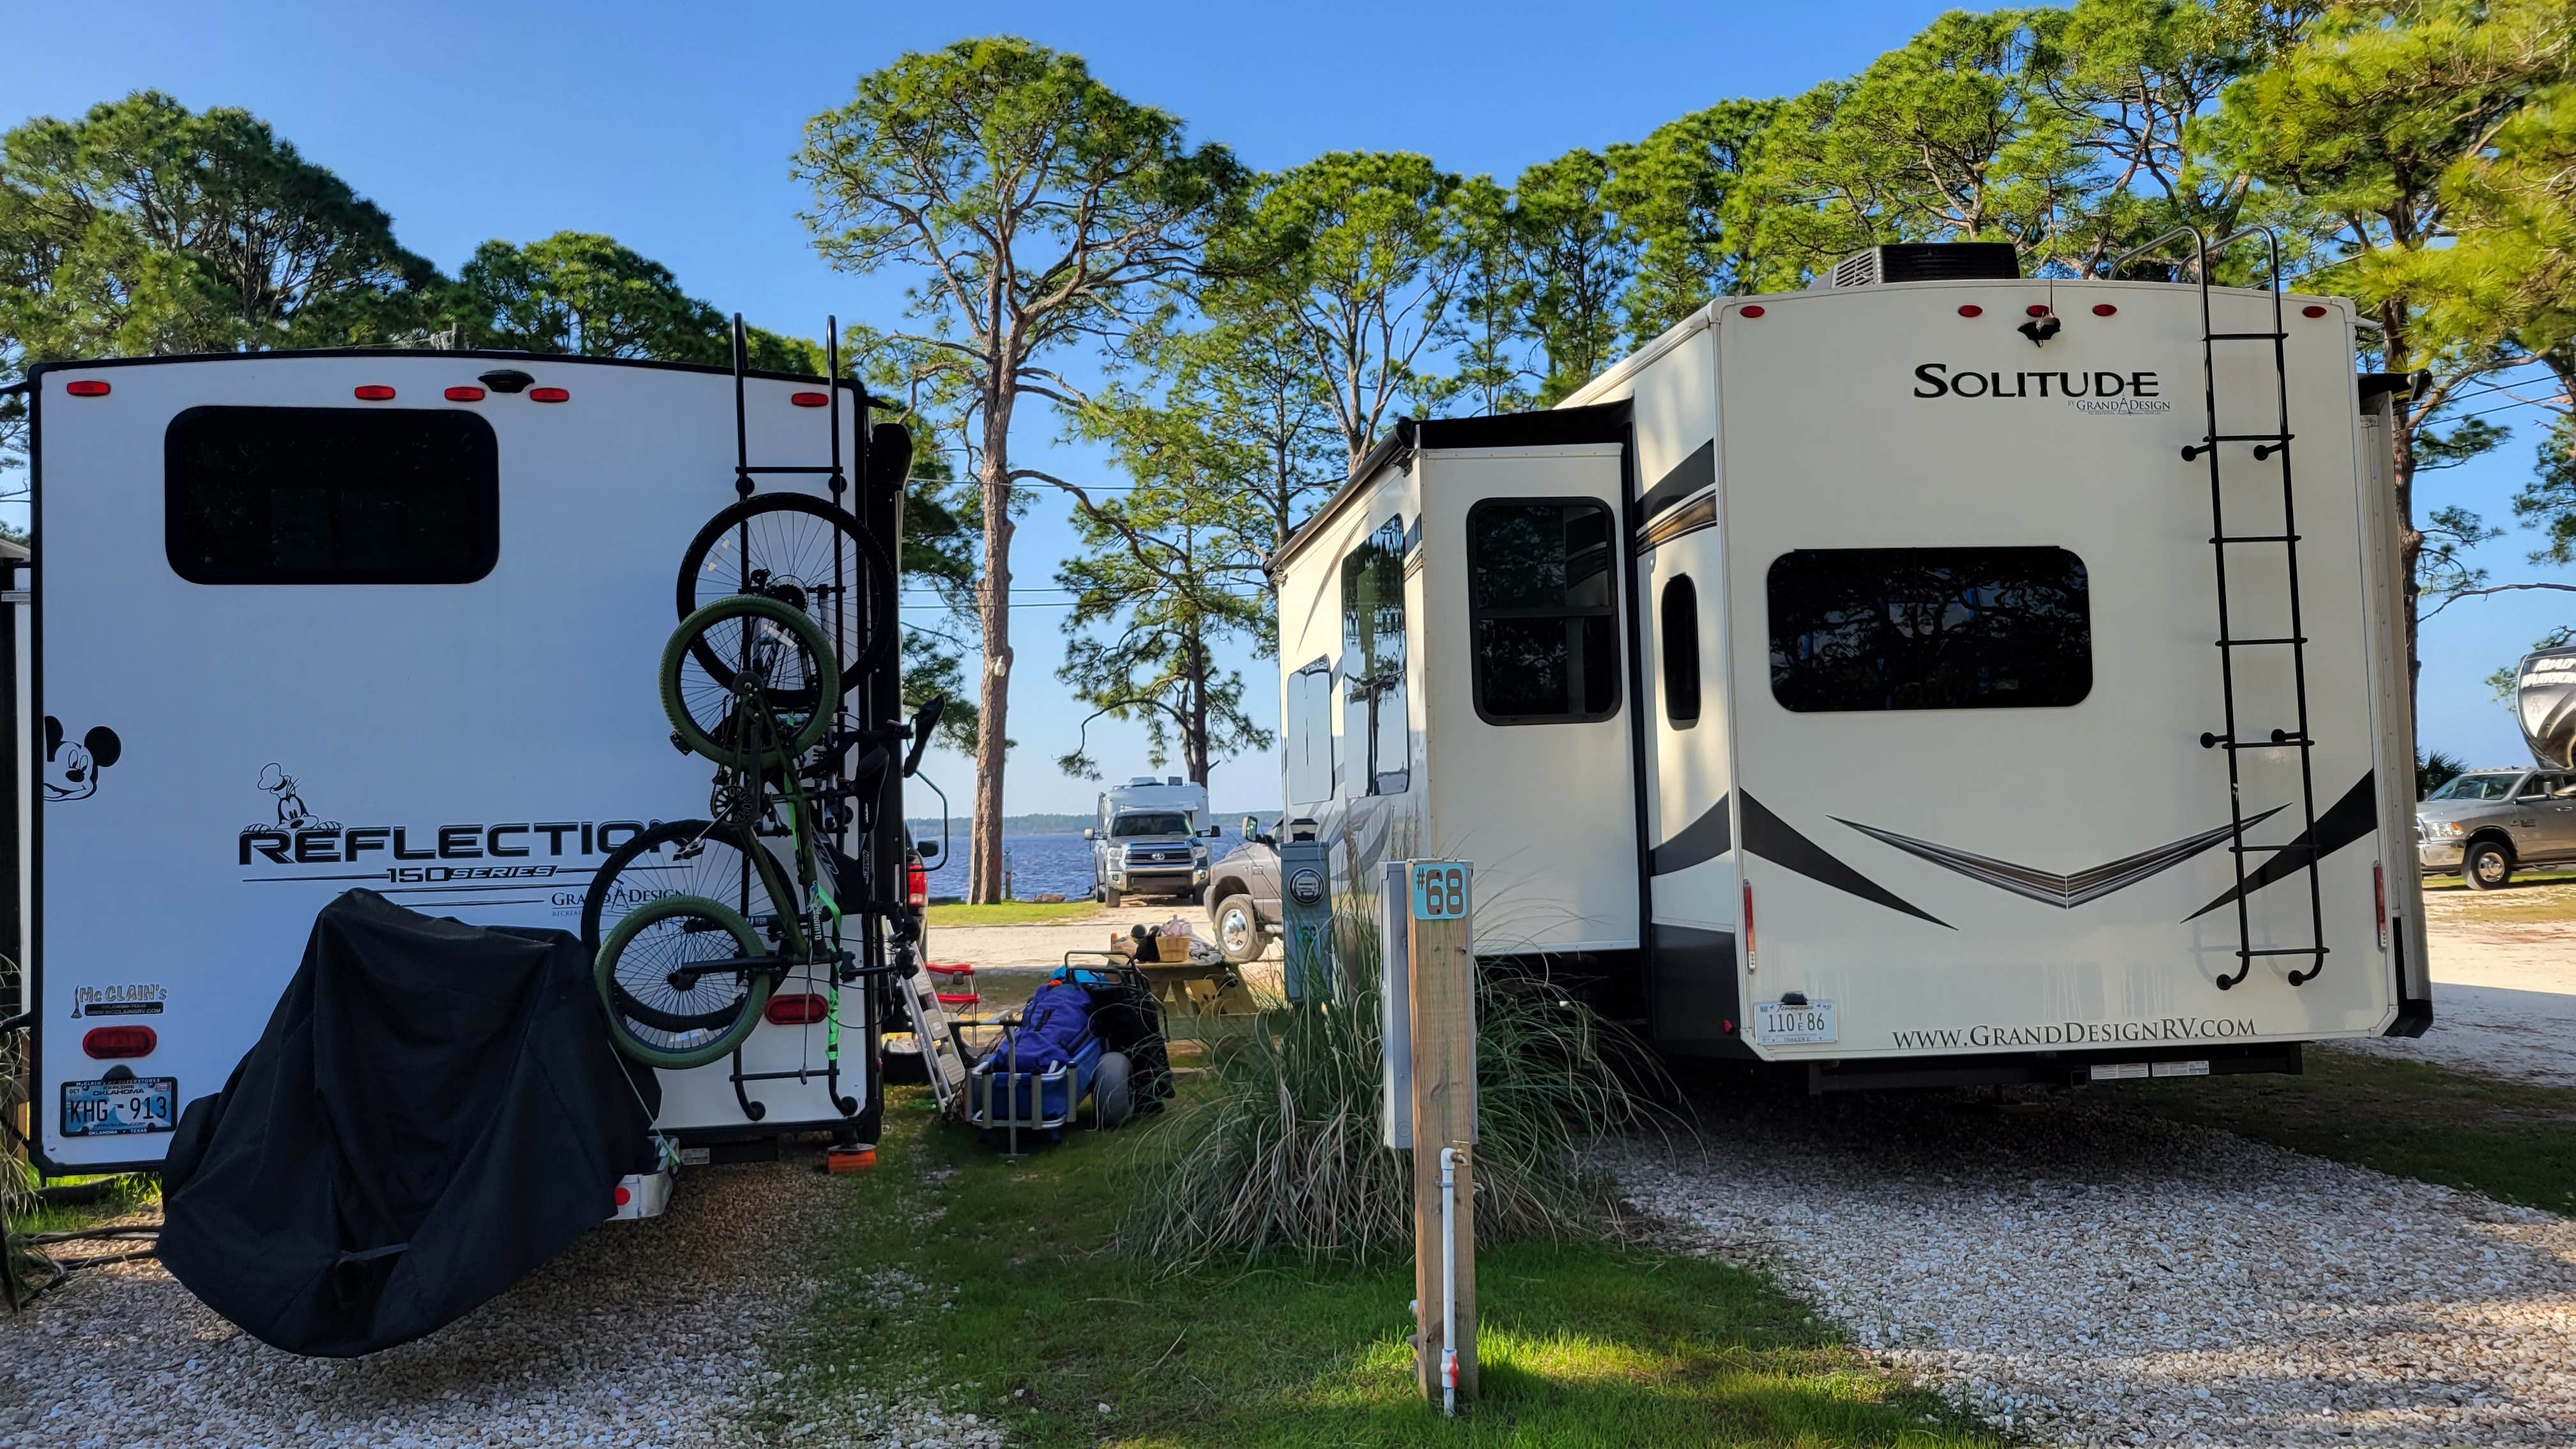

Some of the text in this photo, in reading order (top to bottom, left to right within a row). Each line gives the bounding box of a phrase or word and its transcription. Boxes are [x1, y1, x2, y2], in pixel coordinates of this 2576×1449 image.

[1913, 363, 2159, 398] SOLITUDE
[2076, 400, 2119, 410] GRAND
[2129, 400, 2171, 410] DESIGN
[387, 866, 555, 883] 150 SERIES
[551, 892, 611, 906] GRAD
[1416, 868, 1464, 916] #68
